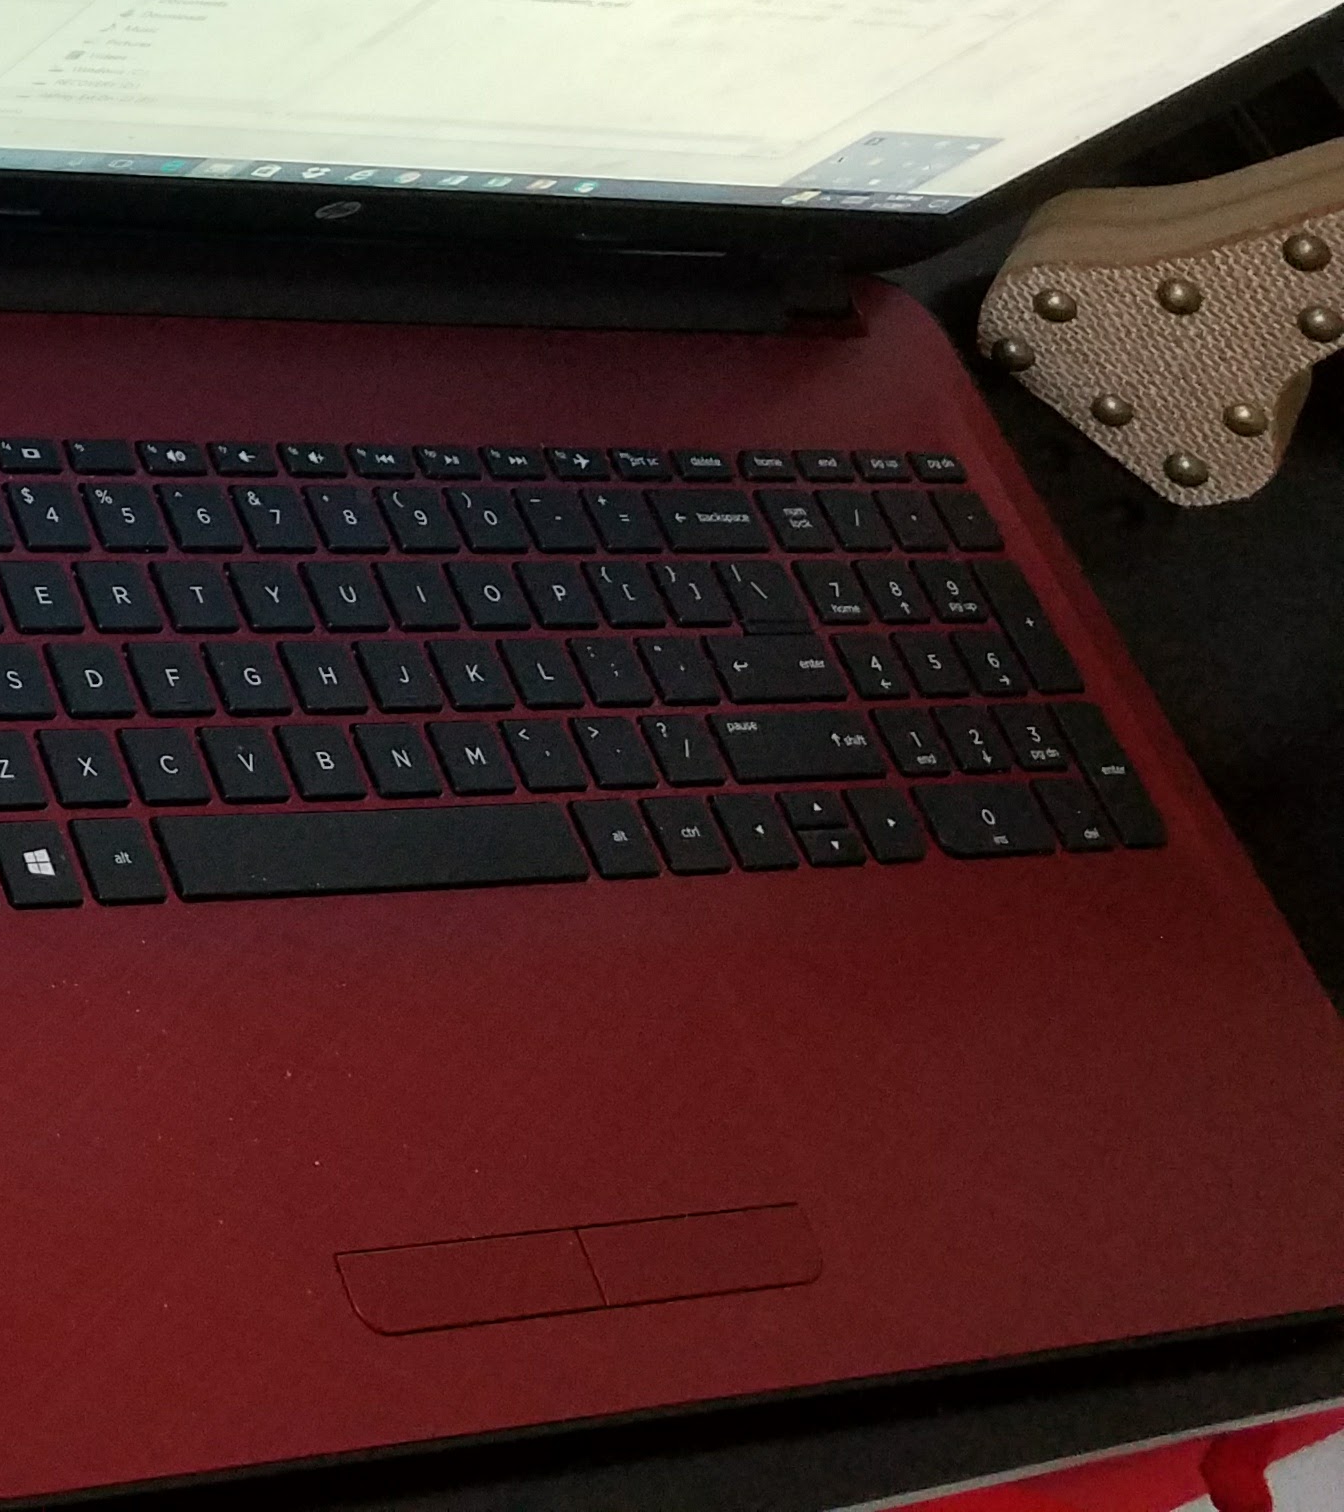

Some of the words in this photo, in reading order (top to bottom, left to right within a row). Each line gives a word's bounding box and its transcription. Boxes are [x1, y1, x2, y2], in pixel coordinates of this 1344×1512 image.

[46, 506, 59, 523] 4
[121, 507, 135, 524] 5
[196, 508, 211, 524] 6
[269, 509, 281, 525] 7
[342, 509, 358, 525] 8
[414, 510, 428, 526] 9
[34, 586, 53, 604] E
[112, 586, 132, 604] R
[189, 586, 204, 604] T
[264, 586, 280, 603] Y
[339, 586, 357, 603] U
[552, 584, 566, 601] P
[6, 670, 23, 689] S
[84, 669, 103, 688] D
[165, 668, 180, 687] F
[243, 667, 262, 686] G
[318, 666, 338, 685] H
[399, 665, 410, 683] J
[465, 664, 485, 682] K
[536, 663, 555, 681] L
[77, 757, 98, 777] X
[160, 755, 179, 774] C
[237, 753, 254, 772] V
[315, 751, 335, 770] B
[391, 749, 412, 768] N
[464, 747, 487, 765] M
[114, 851, 132, 864] alt
